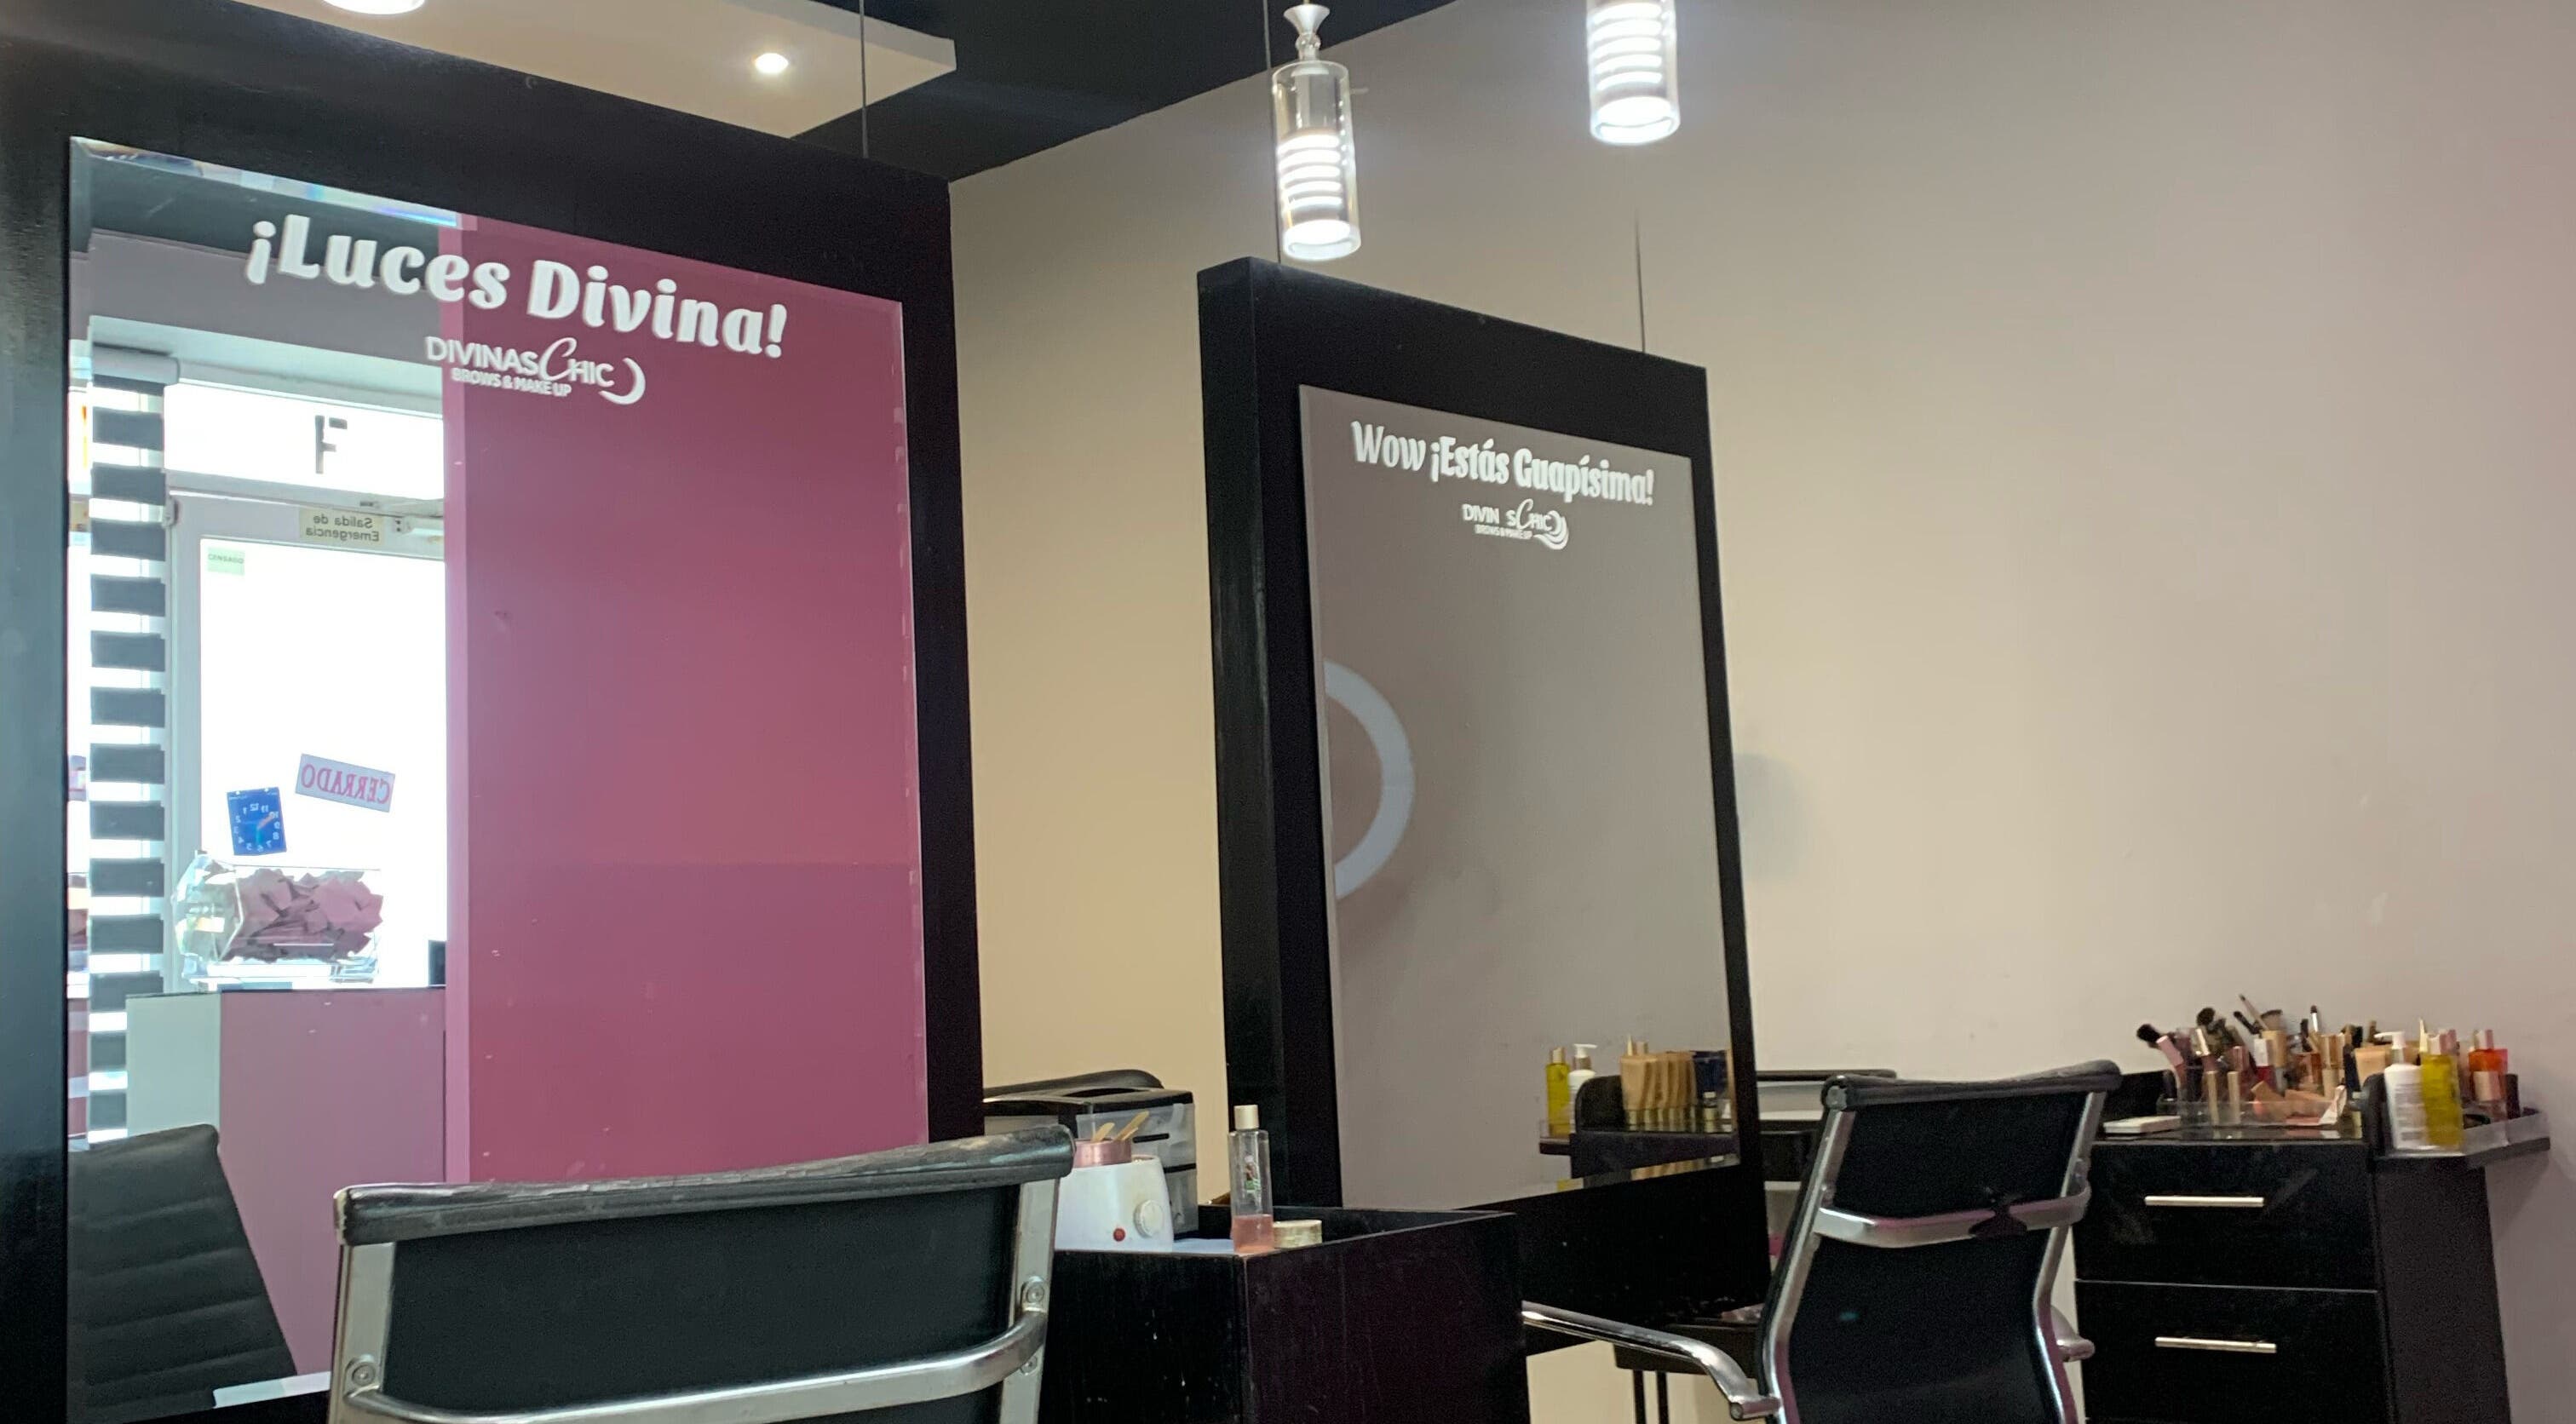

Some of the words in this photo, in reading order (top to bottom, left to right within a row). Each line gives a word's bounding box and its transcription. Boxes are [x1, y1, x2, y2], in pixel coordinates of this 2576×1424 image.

[244, 214, 510, 309] ¡Luces
[527, 260, 787, 358] Divina!
[451, 367, 501, 388] BROWS
[503, 375, 513, 389] &
[514, 376, 552, 395] MAKE
[553, 382, 572, 397] UP
[1351, 421, 1426, 471] Wow
[1430, 436, 1509, 484] ¡Estás
[1514, 448, 1653, 506] Guapísima!
